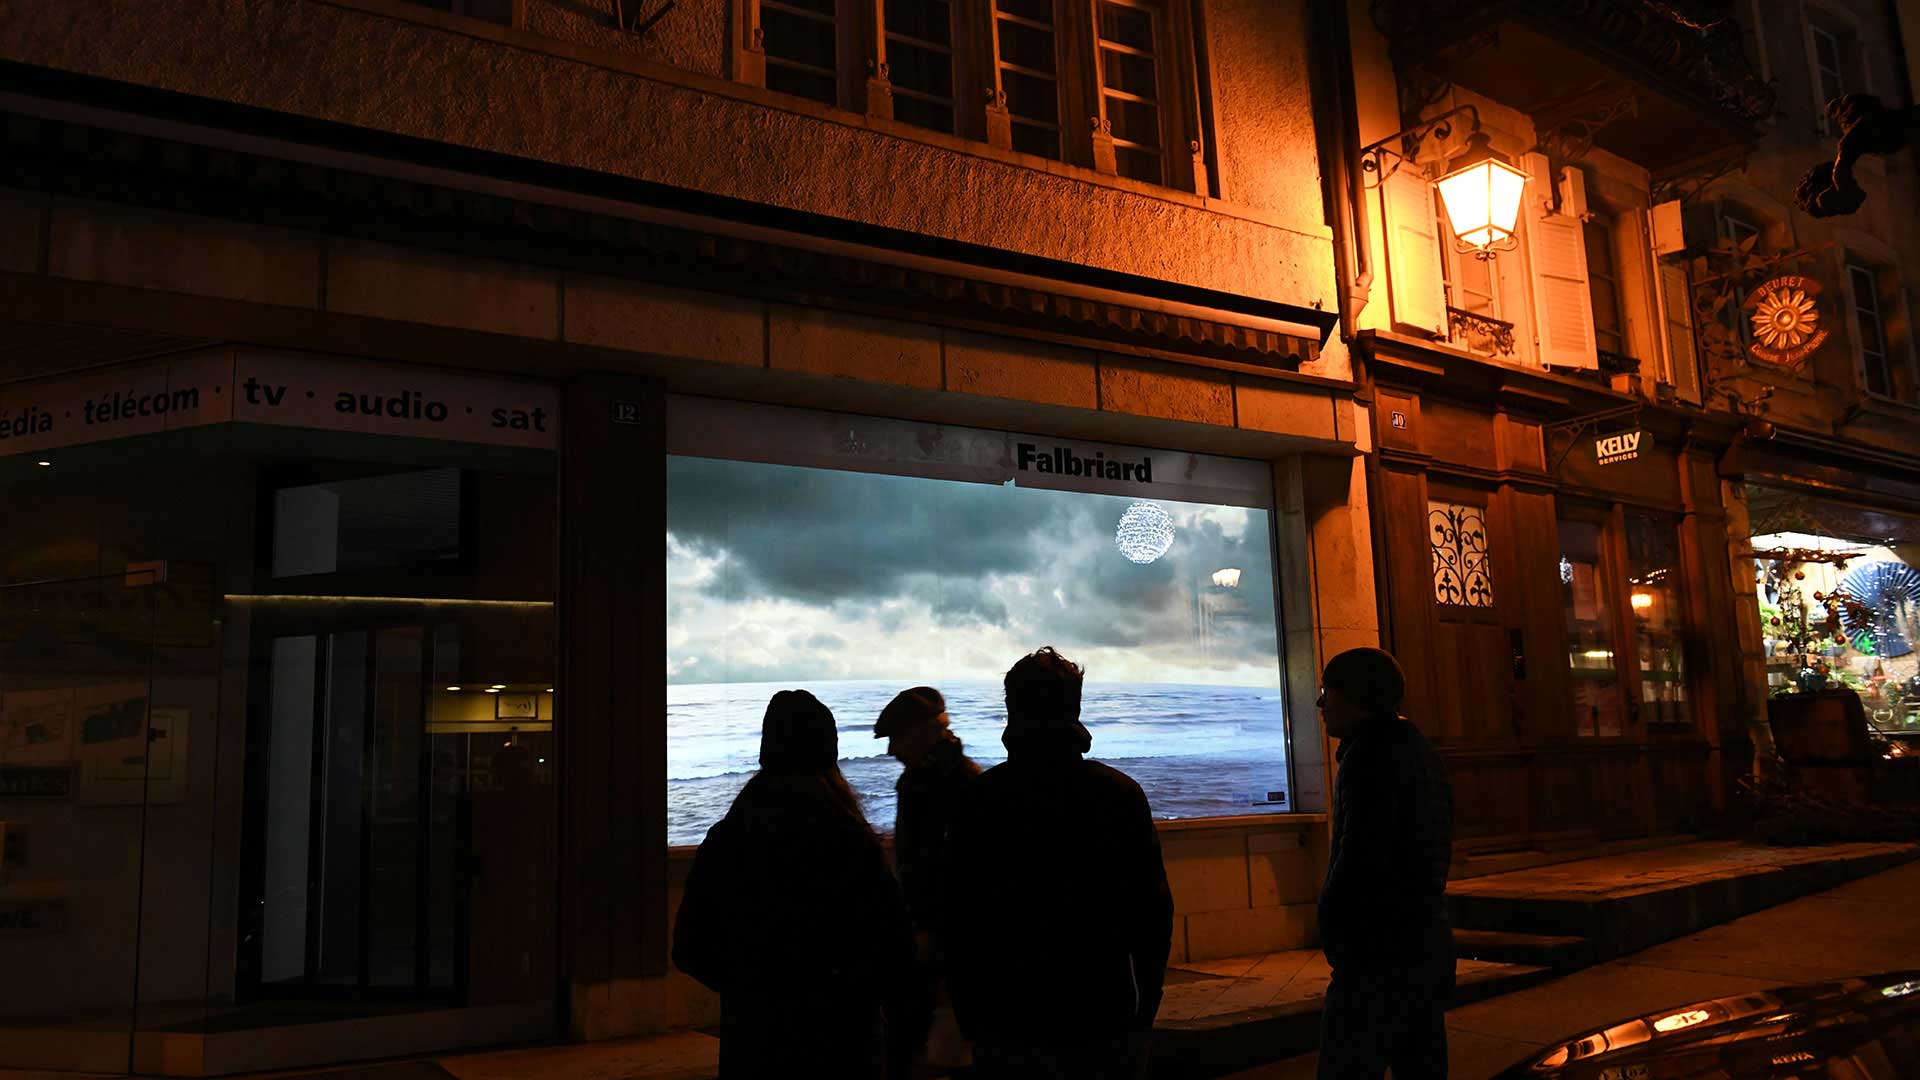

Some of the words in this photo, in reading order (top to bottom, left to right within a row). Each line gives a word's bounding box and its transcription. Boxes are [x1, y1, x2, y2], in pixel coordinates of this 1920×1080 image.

[84, 387, 199, 425] télécom
[243, 377, 287, 406] tv
[335, 391, 448, 421] audio
[491, 405, 546, 432] sat
[616, 404, 635, 421] 12
[1596, 431, 1641, 458] KELLY
[1598, 451, 1639, 466] SERVICES
[1017, 443, 1153, 483] Falbriard
